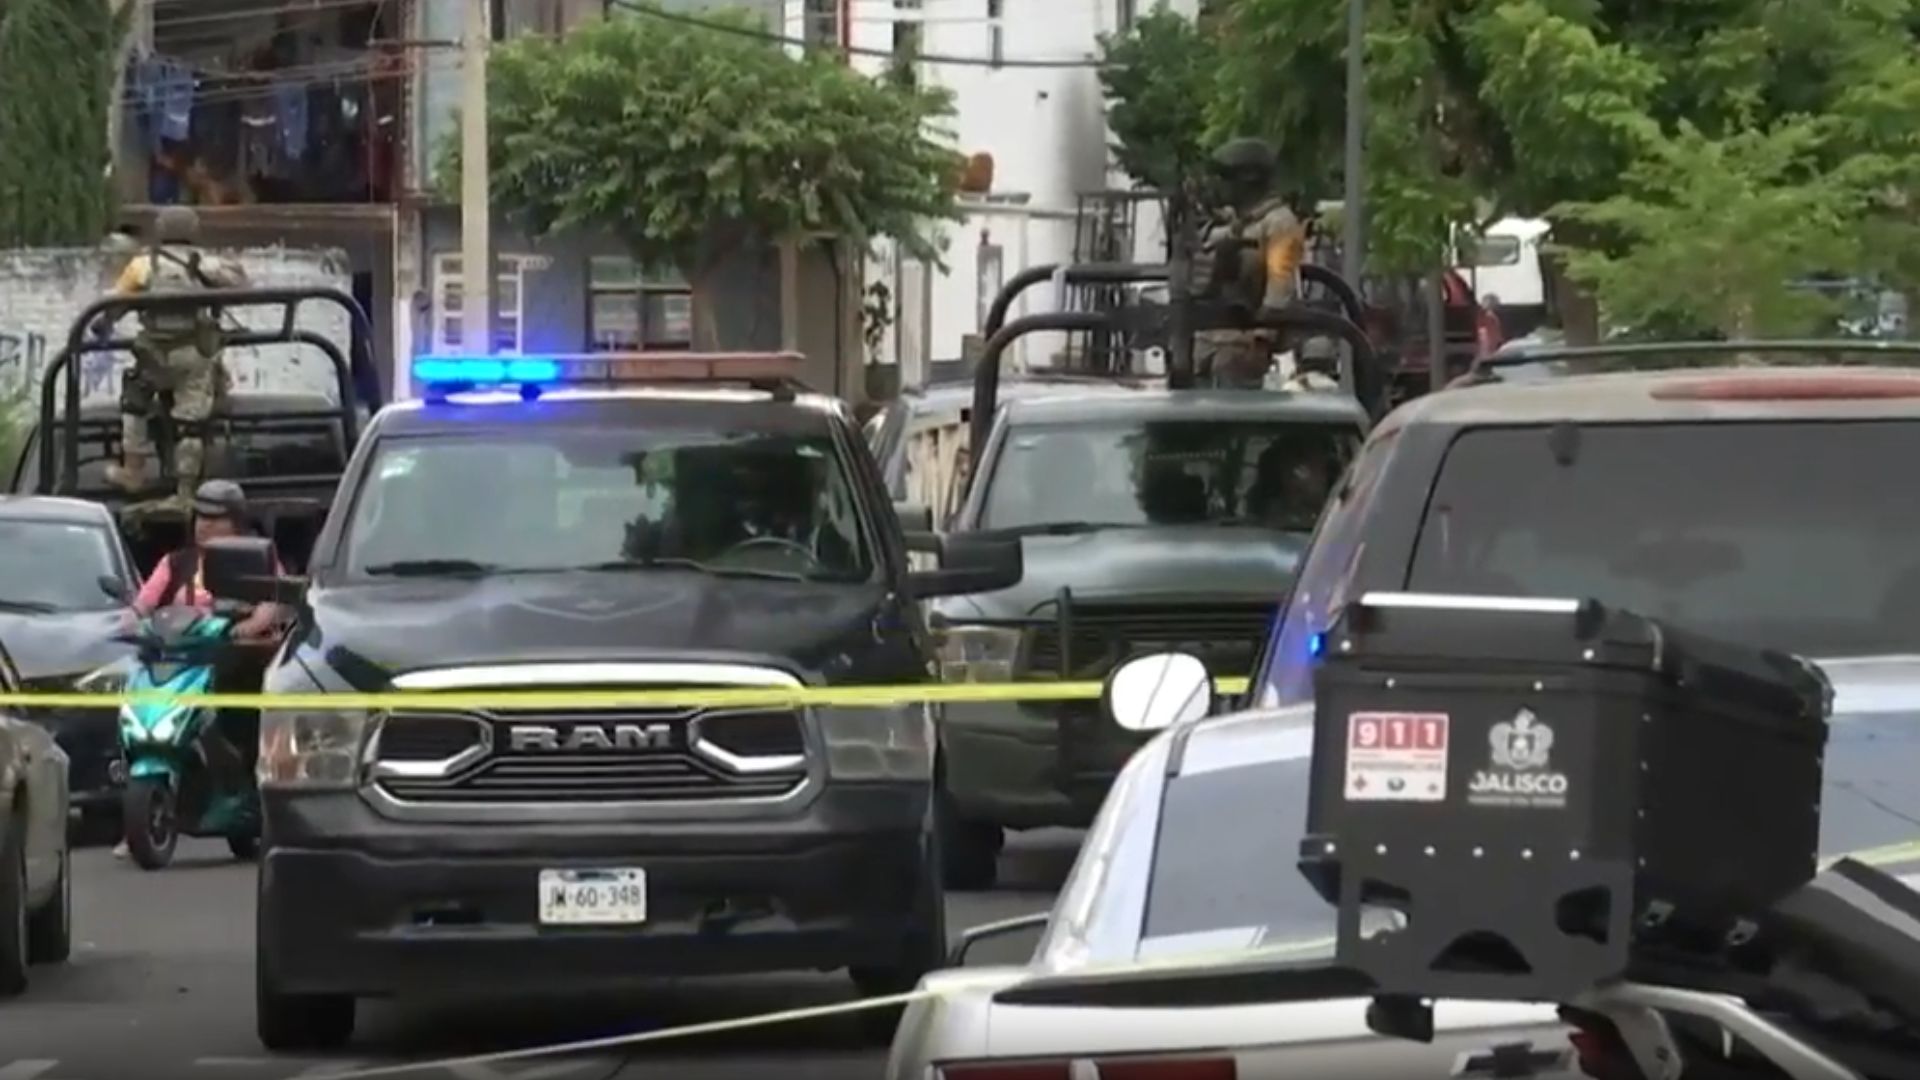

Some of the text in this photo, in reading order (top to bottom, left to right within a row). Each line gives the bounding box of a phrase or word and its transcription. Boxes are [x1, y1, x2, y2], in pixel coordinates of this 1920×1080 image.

[510, 724, 671, 750] RAM
[1358, 721, 1438, 747] 911
[1468, 769, 1568, 793] JALISCO
